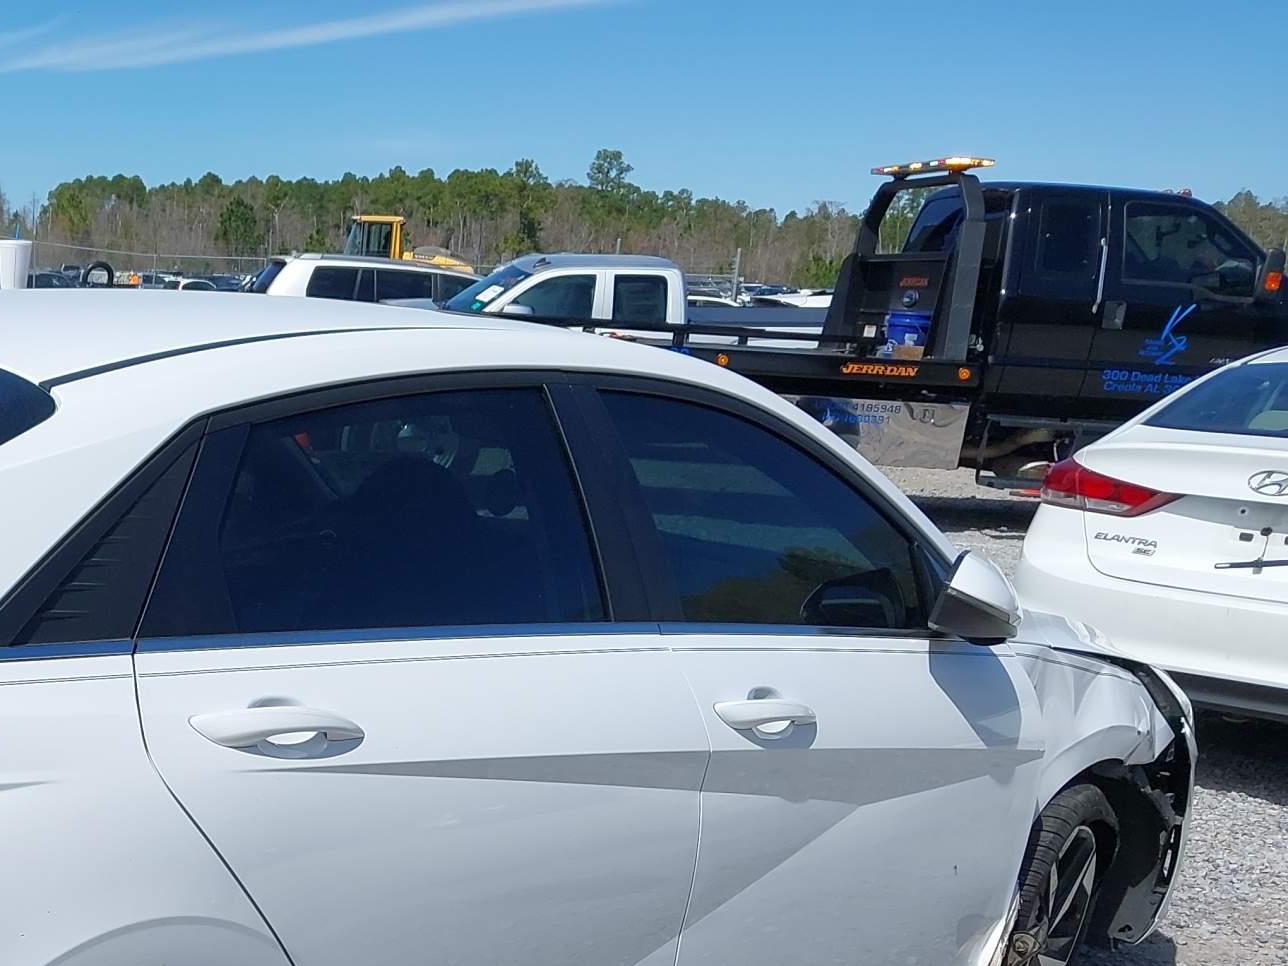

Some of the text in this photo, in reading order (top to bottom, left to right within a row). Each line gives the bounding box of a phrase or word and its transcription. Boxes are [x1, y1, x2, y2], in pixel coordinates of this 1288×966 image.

[1102, 369, 1129, 381] 300
[1131, 371, 1163, 383] Dead
[1094, 532, 1158, 549] ELANTRA
